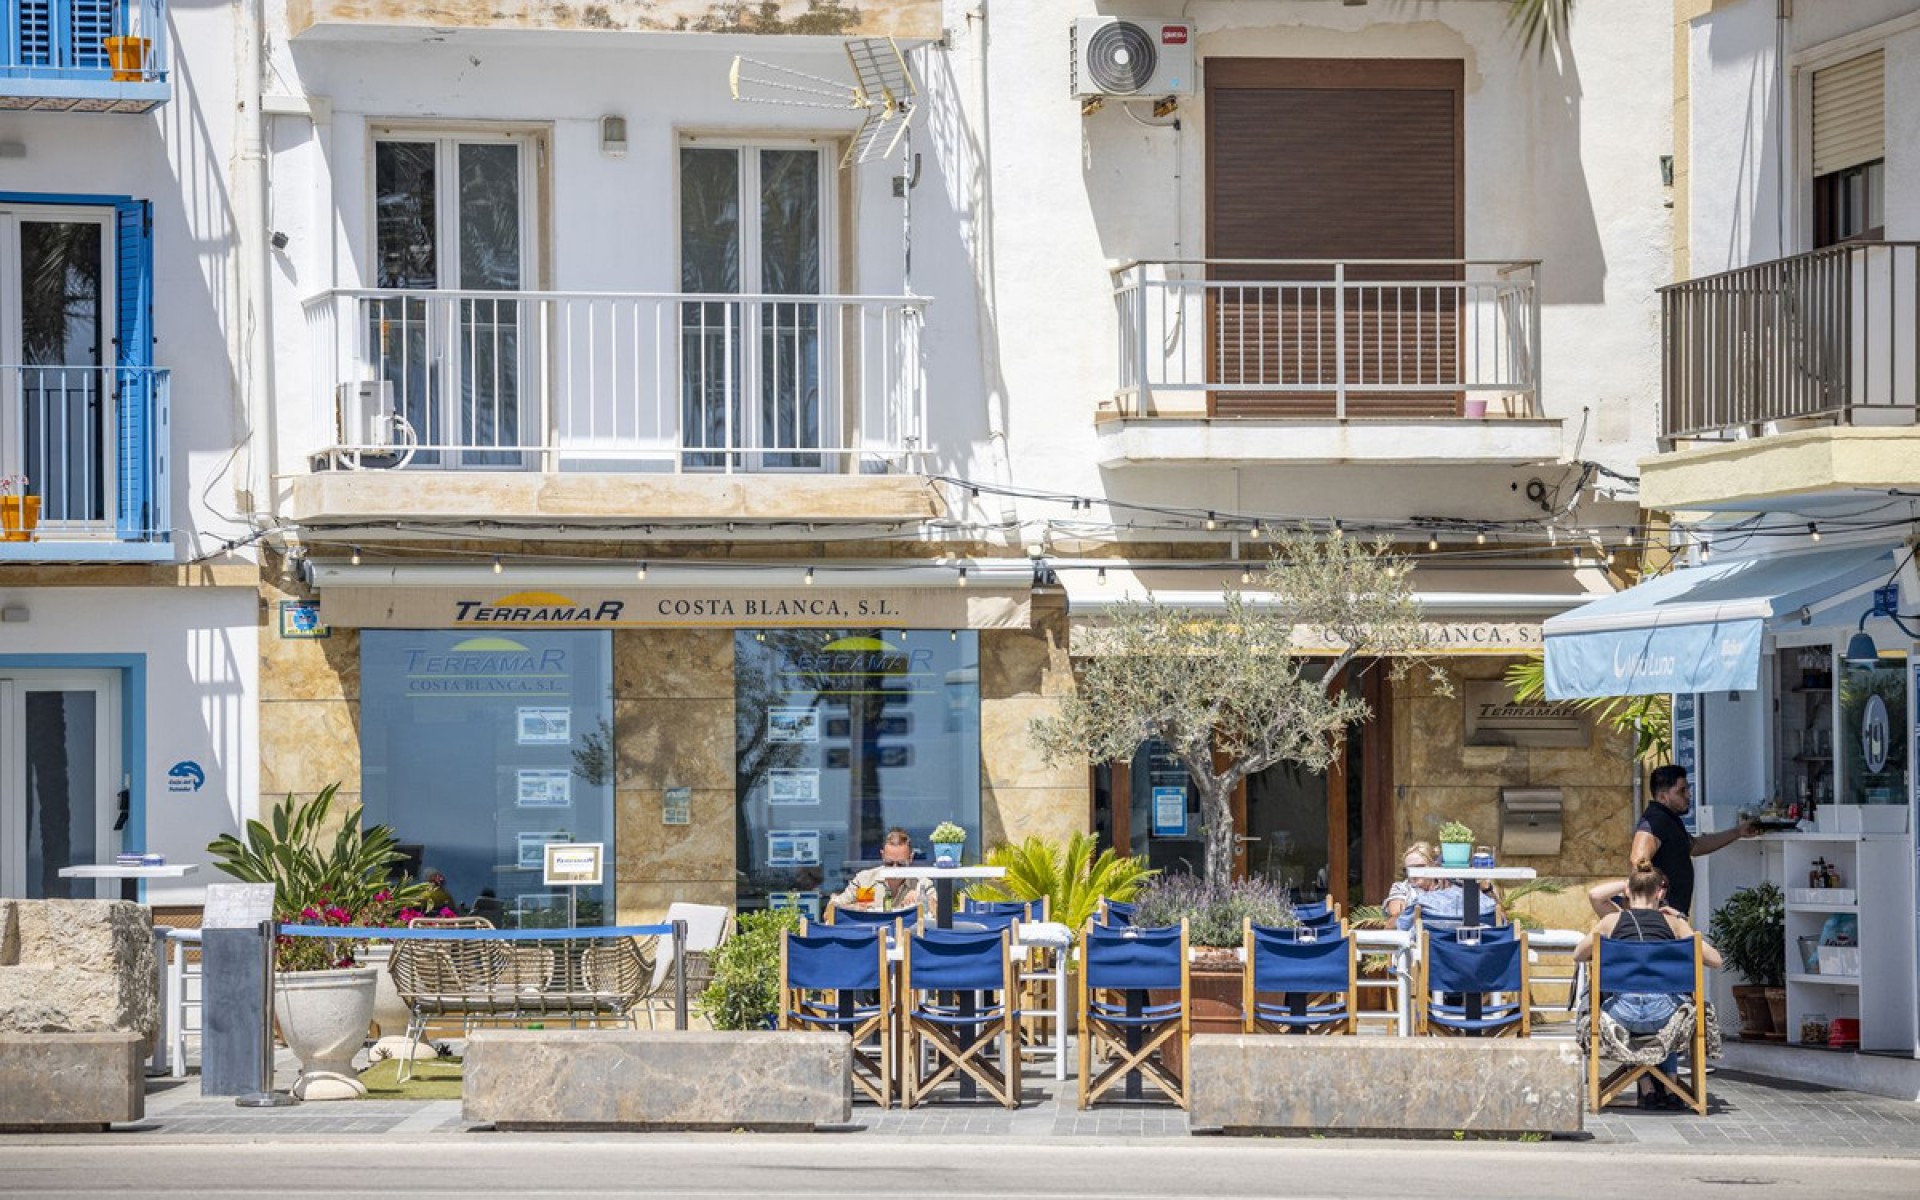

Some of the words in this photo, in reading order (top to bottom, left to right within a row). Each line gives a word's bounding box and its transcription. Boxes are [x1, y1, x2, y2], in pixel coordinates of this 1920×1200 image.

[455, 600, 625, 621] TERRAMAR
[658, 599, 735, 615] COSTA
[745, 599, 849, 617] BLANCA,
[858, 599, 900, 615] S.L.
[403, 648, 565, 673] TERRAMAR
[409, 679, 460, 690] COSTA
[464, 679, 533, 692] BLANCA,
[537, 679, 562, 690] S.L.
